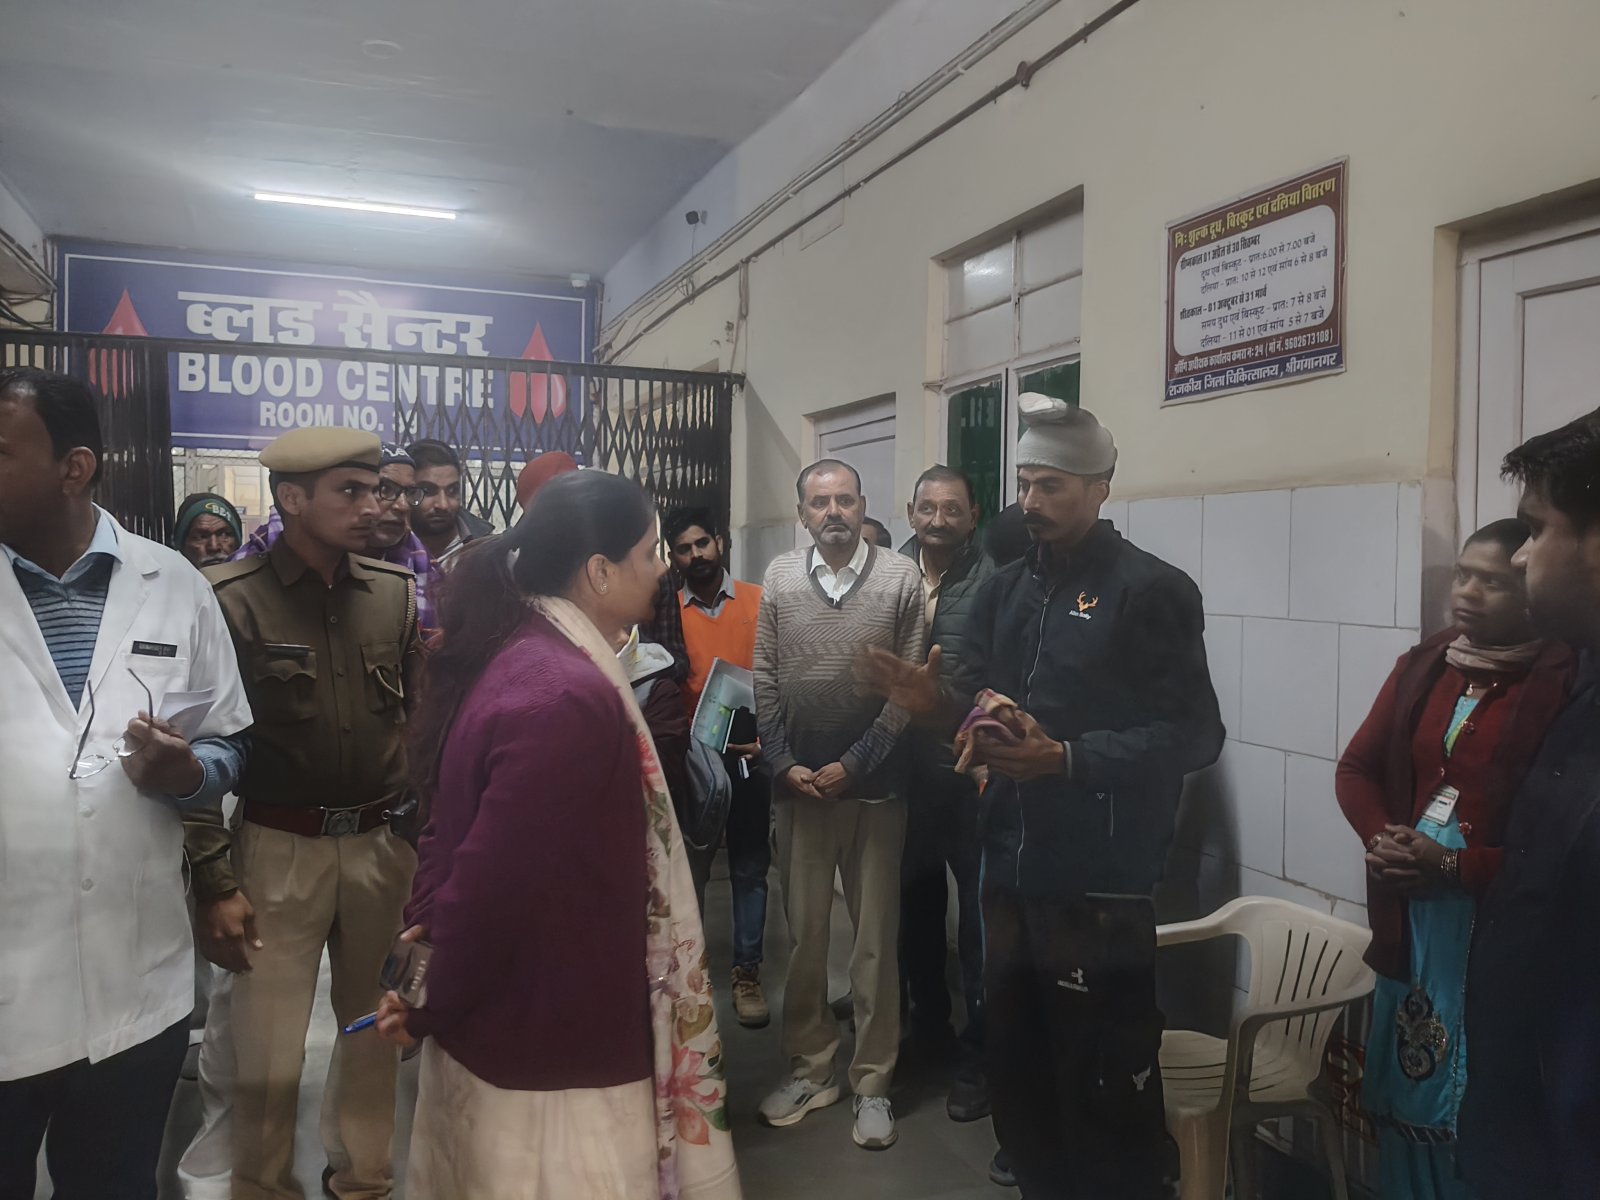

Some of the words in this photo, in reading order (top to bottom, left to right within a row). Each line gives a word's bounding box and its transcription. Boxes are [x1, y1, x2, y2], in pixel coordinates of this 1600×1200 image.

[1256, 197, 1270, 218] एवं
[1270, 190, 1300, 212] दलिया
[1302, 177, 1336, 203] वितरण
[1232, 241, 1239, 253] 30
[1241, 272, 1248, 281] 10
[1250, 268, 1256, 278] से
[1258, 267, 1266, 276] 12
[1294, 257, 1298, 266] 6
[1300, 252, 1307, 263] से
[1309, 252, 1313, 262] 8
[1208, 301, 1216, 312] 01
[1245, 291, 1253, 302] 31
[1290, 297, 1295, 307] 7
[1297, 291, 1304, 305] से
[1307, 292, 1311, 303] 8
[178, 291, 323, 345] ब्लड
[332, 290, 493, 357] सैन्टर
[1200, 334, 1220, 347] दलिया
[1229, 330, 1236, 340] 11
[1238, 326, 1244, 338] से
[1246, 326, 1255, 336] 01
[1288, 316, 1293, 327] 5
[1295, 311, 1301, 325] से
[1304, 312, 1308, 322] 7
[1310, 305, 1324, 320] बजे
[178, 352, 323, 397] BLOOD
[337, 361, 494, 408] CENTRE
[1168, 378, 1201, 396] राजकीय
[1204, 374, 1225, 389] जिला
[1285, 353, 1337, 373] श्रीगंगानगर
[260, 401, 334, 428] ROOM
[343, 405, 384, 431] NO.
